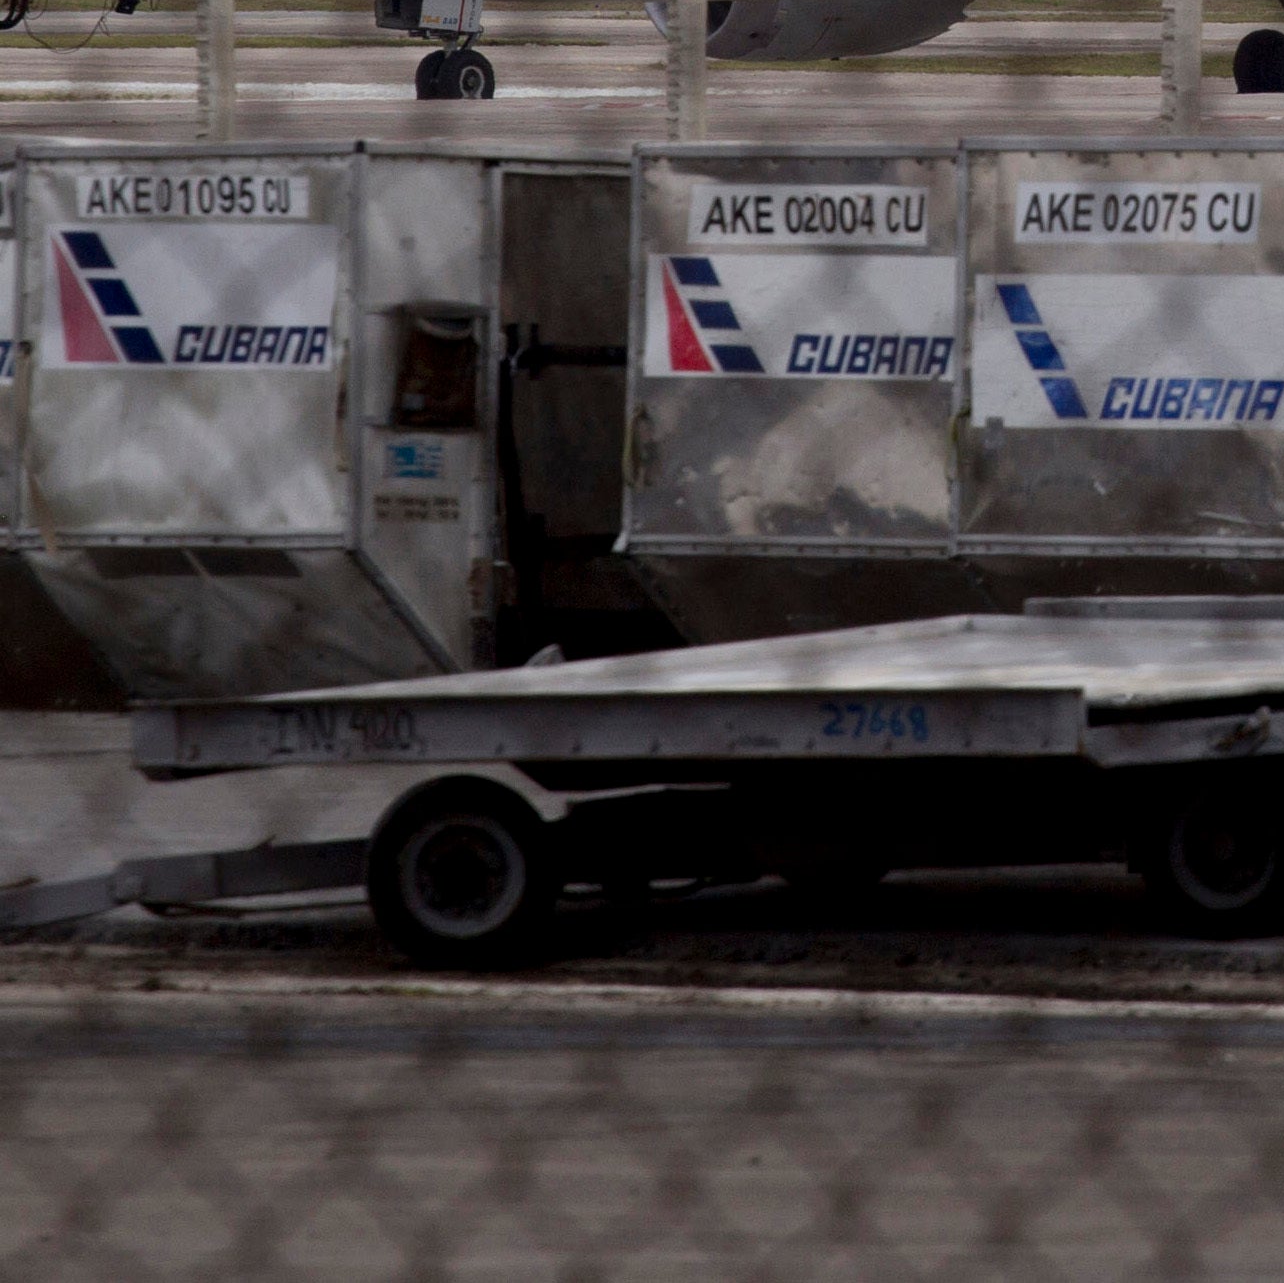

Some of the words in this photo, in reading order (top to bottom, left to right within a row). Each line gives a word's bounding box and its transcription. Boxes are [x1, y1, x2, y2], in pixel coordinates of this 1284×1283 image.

[262, 178, 291, 214] CU
[702, 195, 775, 234] AKE
[784, 193, 874, 234] 02004
[886, 194, 924, 232] CU
[1022, 193, 1095, 232] AKE
[1103, 193, 1198, 232] 02075
[1207, 192, 1256, 232] CU
[173, 325, 330, 364] CUBANA
[786, 334, 954, 375] CUBANA
